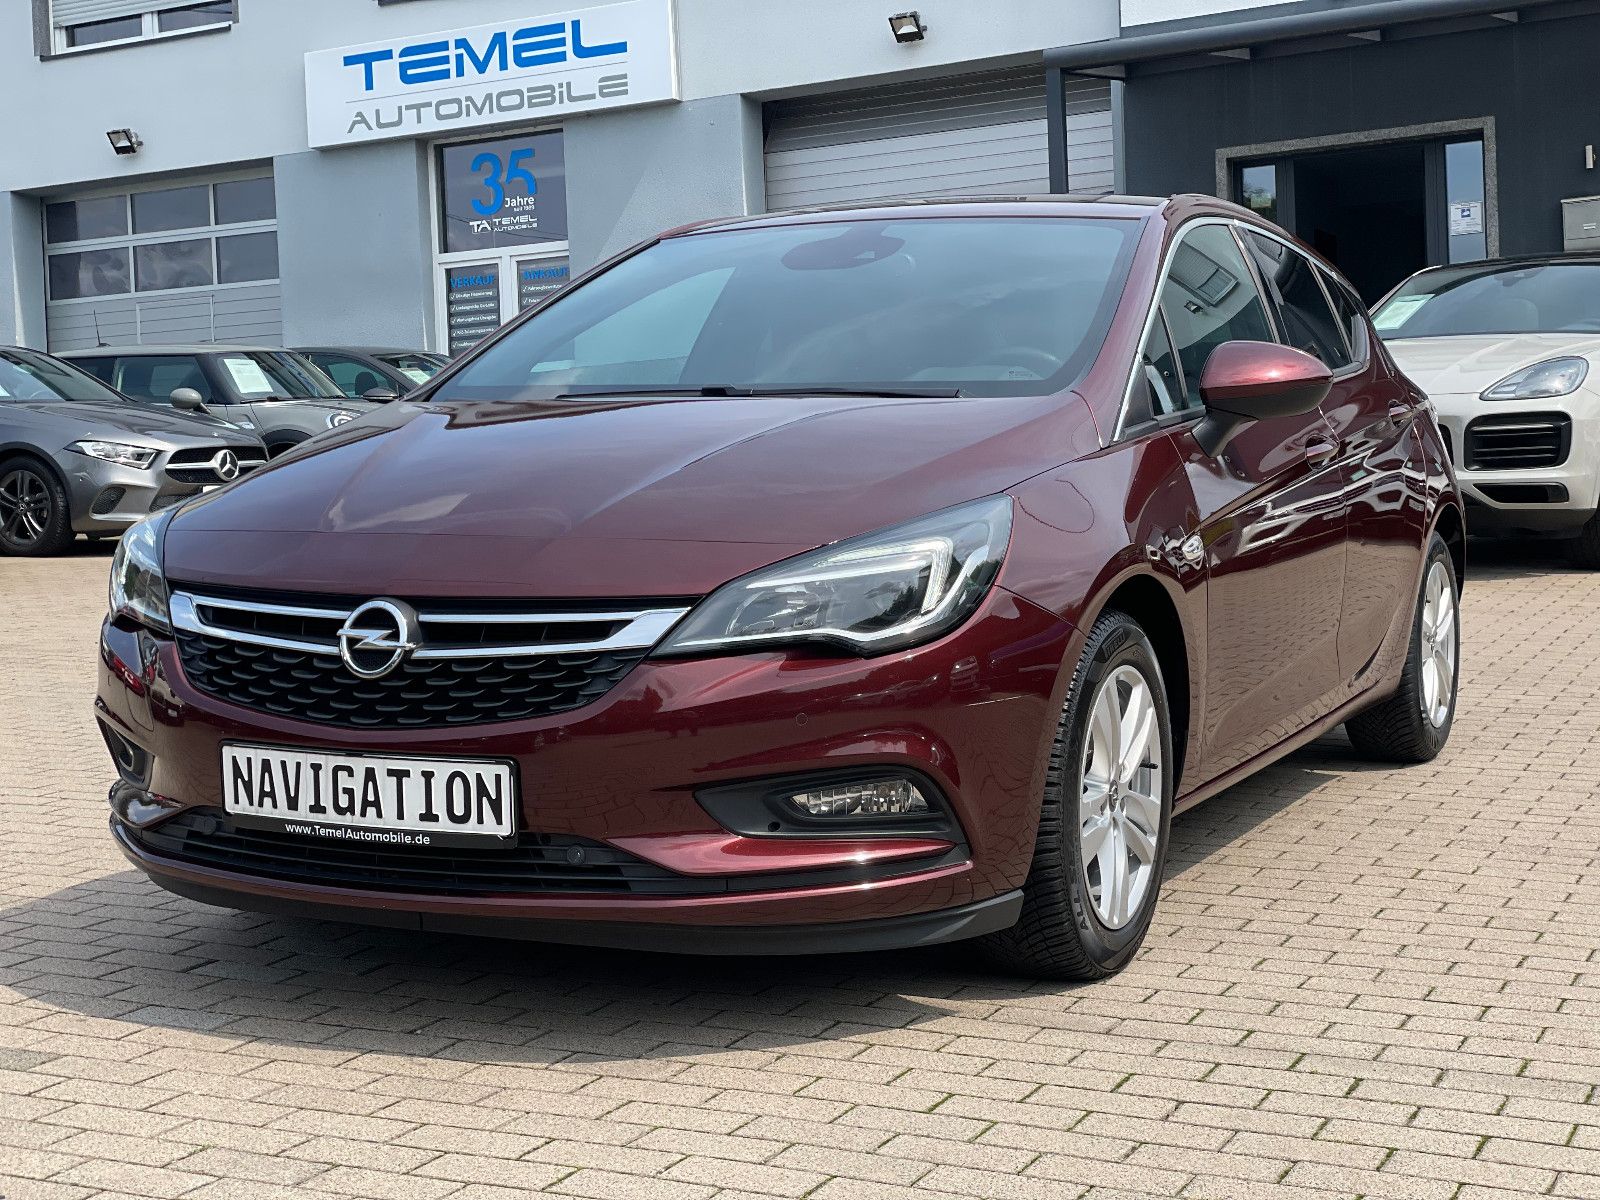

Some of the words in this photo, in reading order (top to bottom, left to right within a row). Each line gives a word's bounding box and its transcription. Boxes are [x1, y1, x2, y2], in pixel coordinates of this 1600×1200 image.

[342, 19, 628, 92] TEMEL
[470, 147, 537, 216] 35
[504, 195, 535, 208] Jahre
[493, 215, 538, 225] TEMEL
[450, 274, 495, 289] VERKAUF
[231, 754, 504, 826] NAVIGATION
[285, 822, 431, 846] www.TemelAutomobile.de
